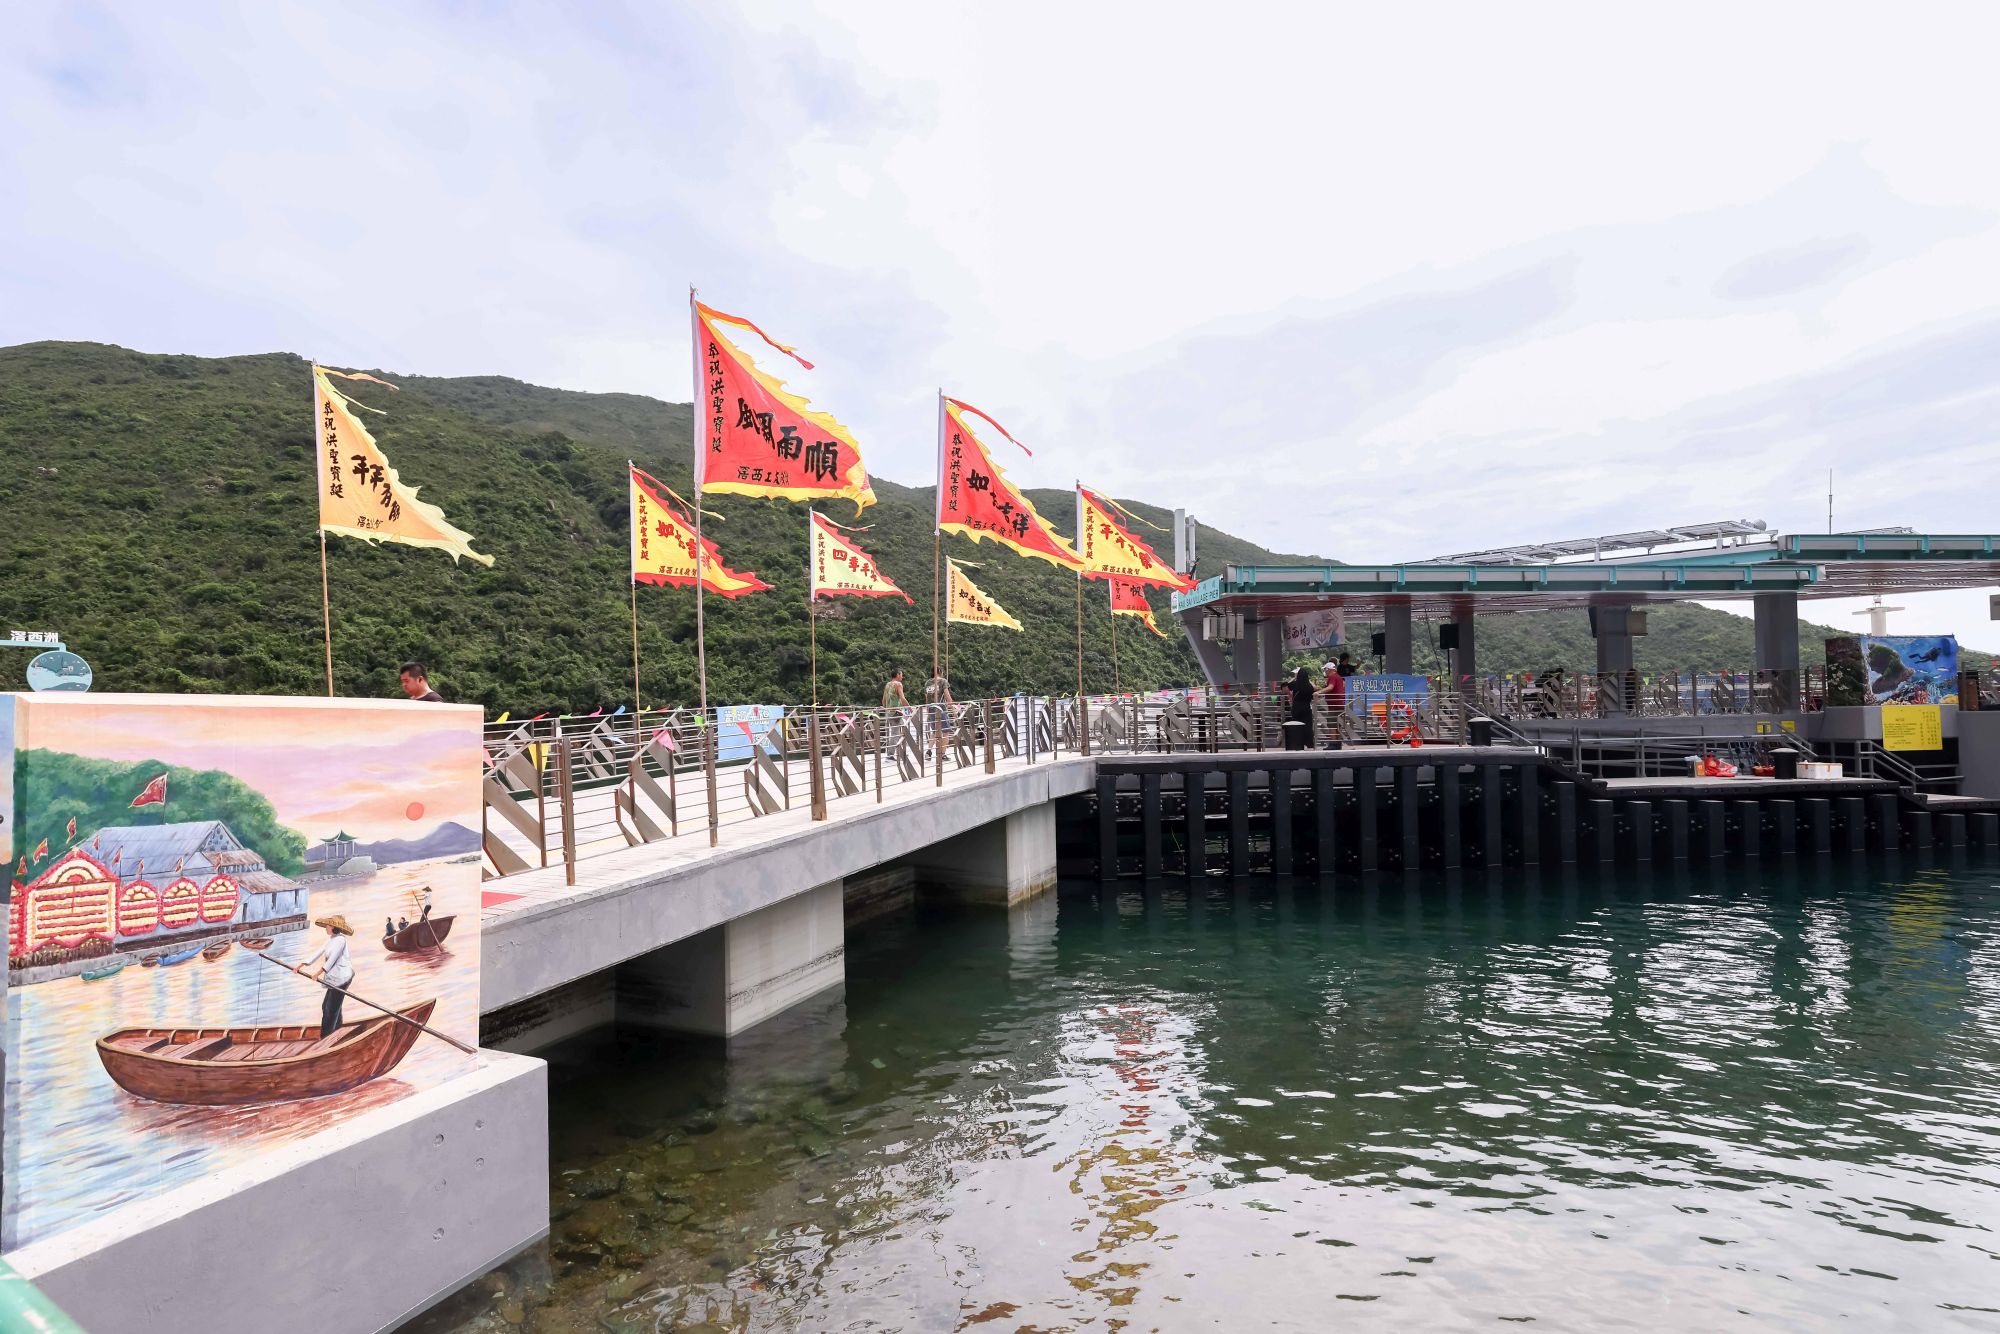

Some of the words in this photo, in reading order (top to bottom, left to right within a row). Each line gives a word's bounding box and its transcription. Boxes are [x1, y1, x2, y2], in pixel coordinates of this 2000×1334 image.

[324, 400, 344, 498] 恭祝洪聖寶誕
[736, 397, 839, 482] 風調雨順
[351, 454, 401, 521] 年年有餘
[949, 433, 963, 511] 恭祝洪聖寶誕
[966, 468, 1030, 538] 如意吉祥
[832, 548, 879, 582] 四季平安
[959, 588, 992, 617] 如意吉祥
[1192, 593, 1209, 604] VILLAGE
[10, 630, 59, 643] 滘西洲
[1352, 679, 1405, 692] 歡迎光臨
